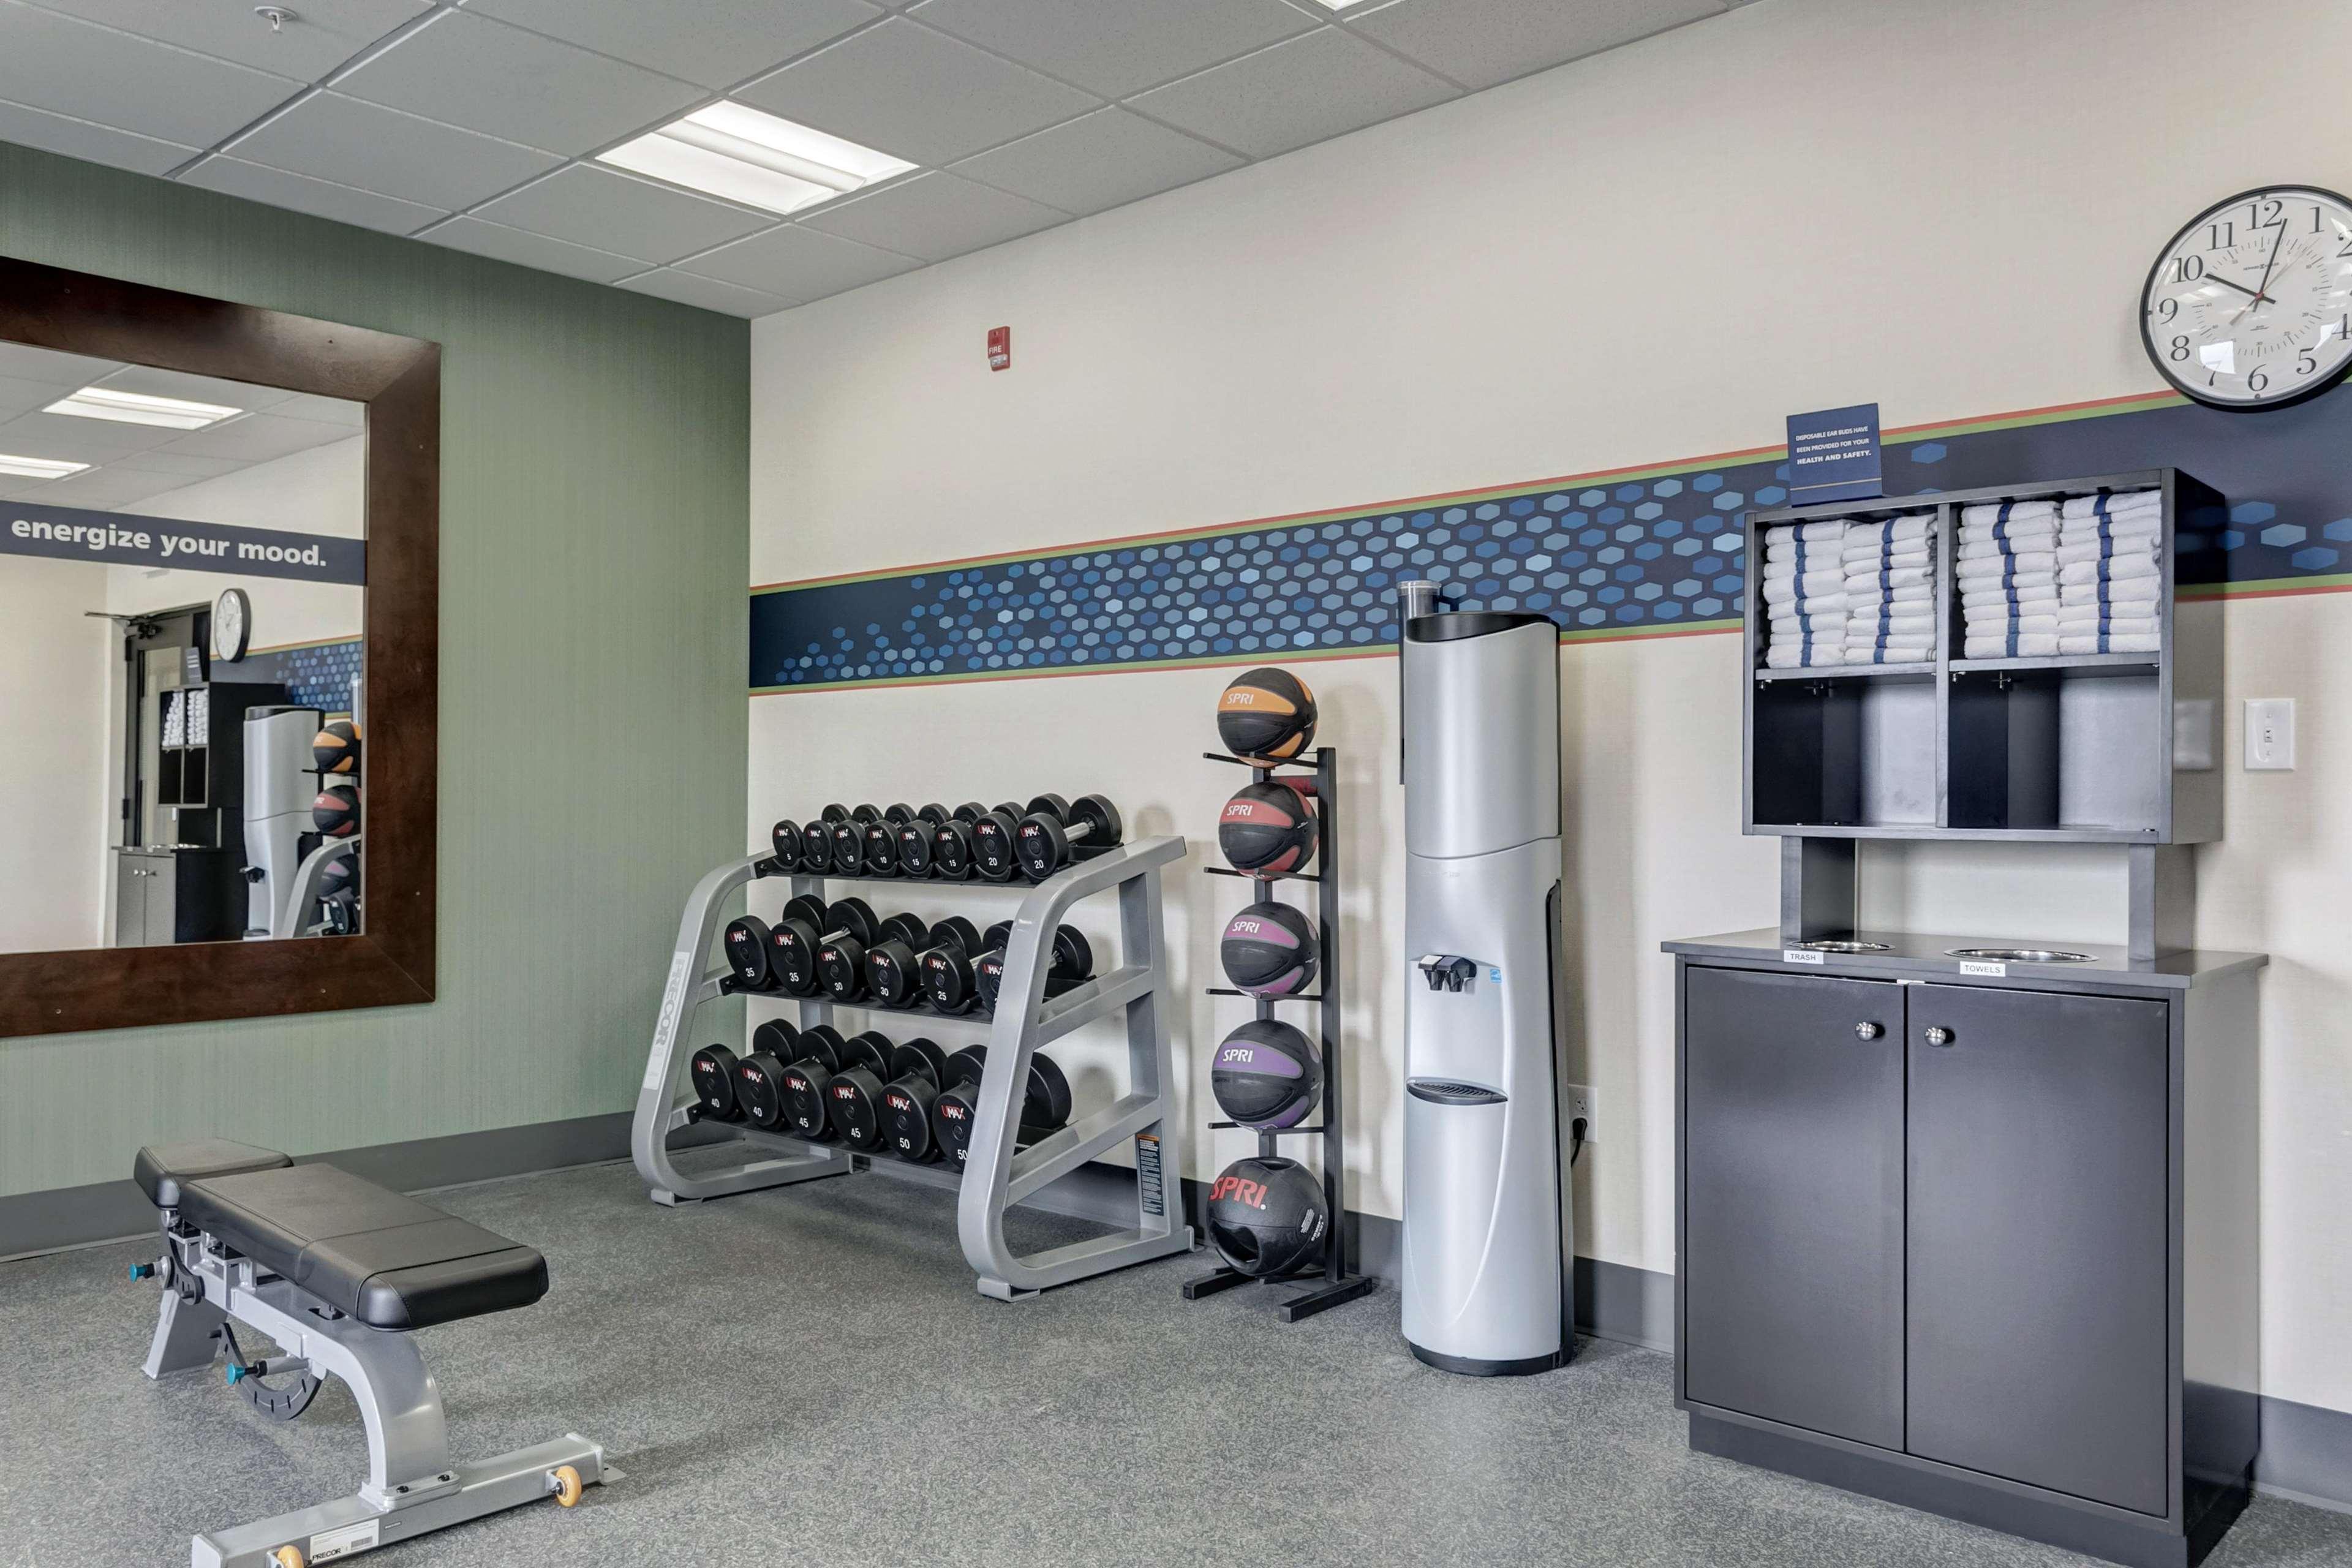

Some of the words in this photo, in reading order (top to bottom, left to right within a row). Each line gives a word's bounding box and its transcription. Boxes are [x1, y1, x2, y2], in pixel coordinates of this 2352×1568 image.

[2245, 200, 2283, 231] 12
[2308, 206, 2324, 234] 1
[2206, 222, 2237, 251] 11
[2171, 255, 2203, 284] 10
[2159, 298, 2178, 325] 9
[989, 345, 1002, 355] FIRE
[2171, 336, 2190, 361] 8
[2296, 347, 2316, 374] 5
[2248, 364, 2268, 391] 6
[1796, 432, 1826, 441] DISPOSABLE
[1811, 442, 1839, 451] PROVIDED
[1797, 456, 1823, 465] HEALTH
[1843, 450, 1871, 459] SAFETY.
[12, 519, 151, 550] energize
[160, 534, 230, 556] your
[238, 545, 326, 566] mood.
[1227, 693, 1254, 704] SPRI
[1227, 805, 1253, 816] SPRI
[989, 858, 998, 866] 20
[1035, 860, 1044, 869] 20
[1232, 921, 1260, 933] SPRI
[745, 967, 755, 977] 35
[1965, 965, 2000, 974] TOWELS
[789, 972, 799, 982] 35
[834, 982, 843, 991] 30
[880, 987, 889, 997] 30
[938, 990, 946, 1001] 25
[1223, 1049, 1253, 1063] SPRI
[834, 1087, 856, 1099] UMAX
[711, 1098, 720, 1108] 40
[887, 1095, 911, 1112] UMAX
[753, 1106, 763, 1117] 40
[941, 1105, 966, 1120] UMAX
[799, 1117, 809, 1128] 45
[851, 1128, 861, 1139] 45
[900, 1137, 910, 1150] 50
[957, 1149, 968, 1161] 50
[312, 1548, 341, 1561] PRECOR
